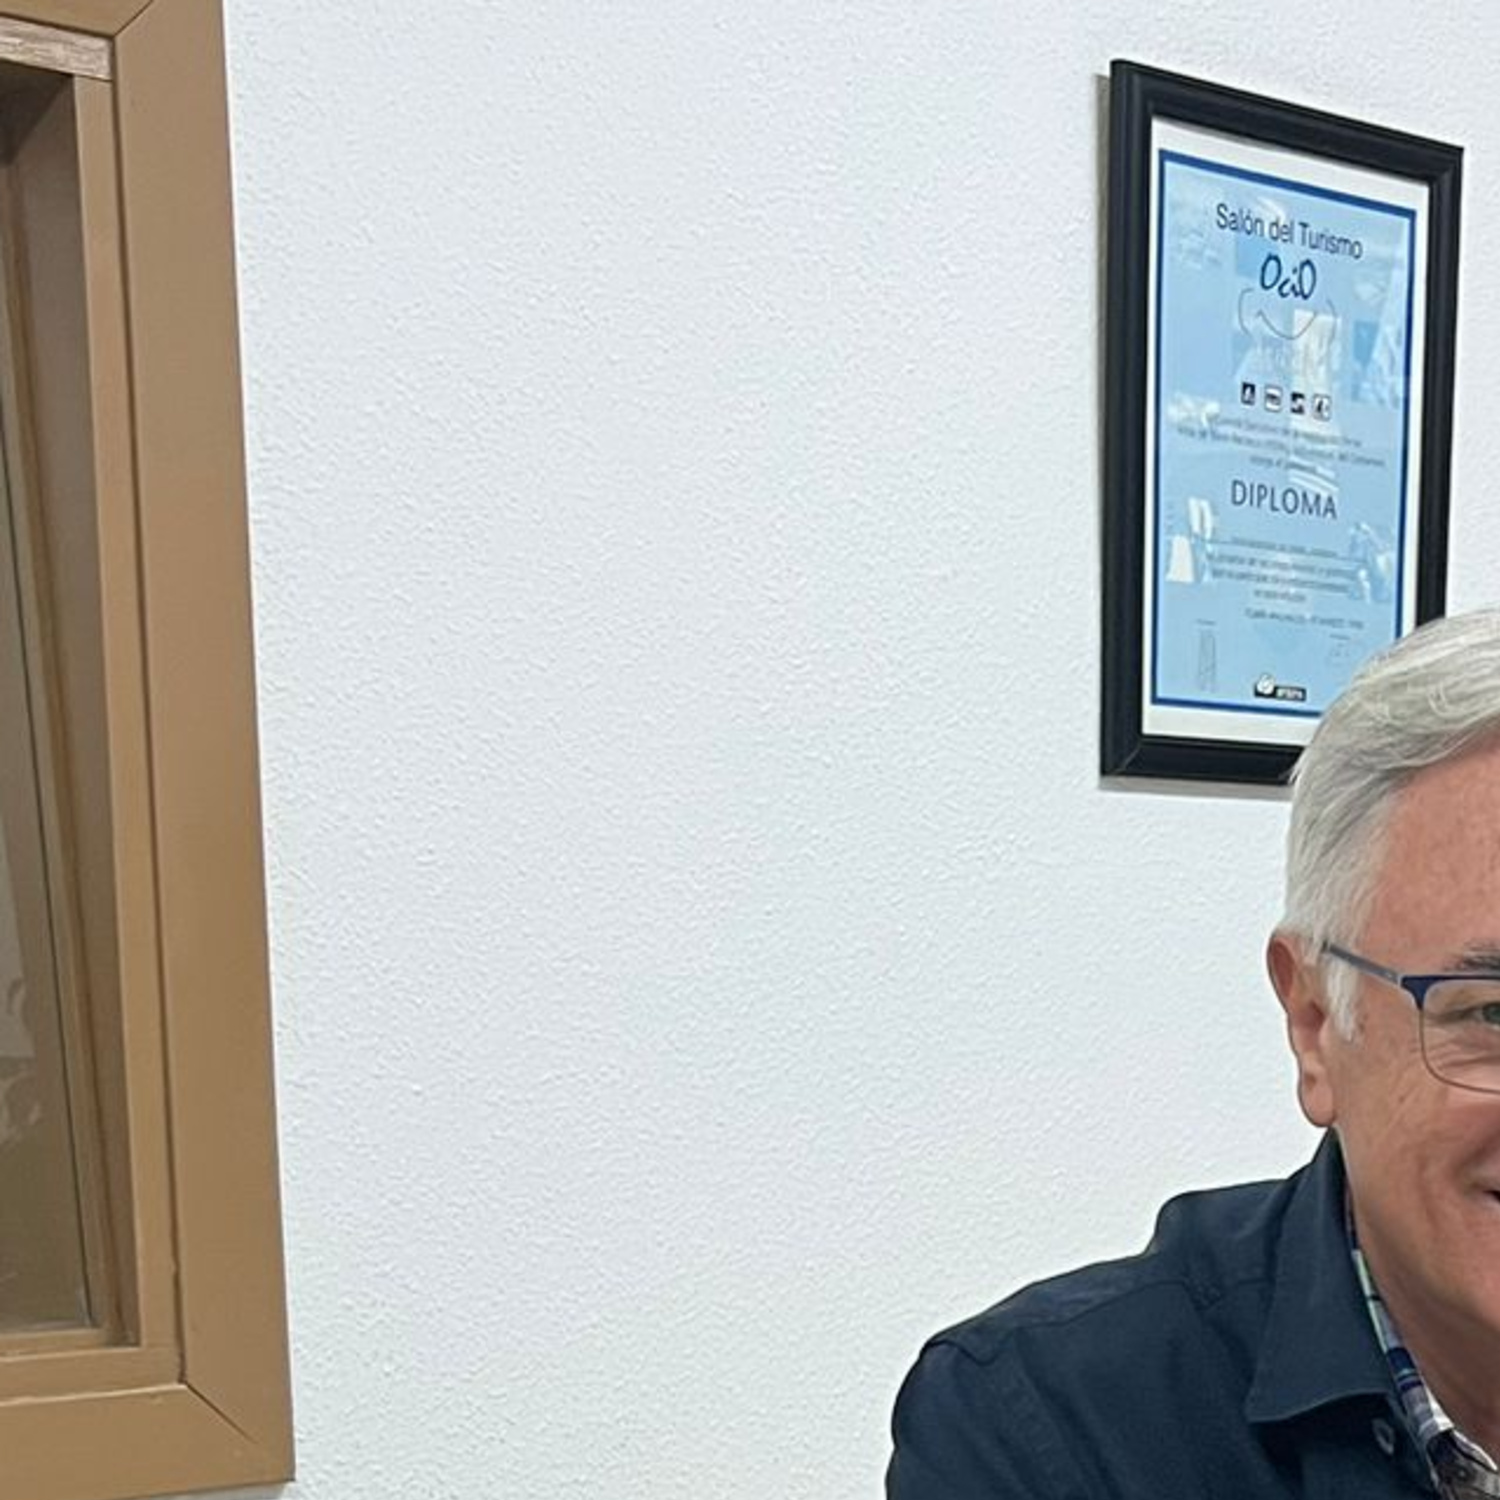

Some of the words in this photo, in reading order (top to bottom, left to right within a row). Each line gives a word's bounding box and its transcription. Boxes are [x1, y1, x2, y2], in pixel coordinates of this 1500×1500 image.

[1216, 203, 1265, 237] Salón
[1268, 216, 1295, 244] del
[1298, 221, 1364, 260] Turismo
[1230, 479, 1338, 520] DIPLOMA
